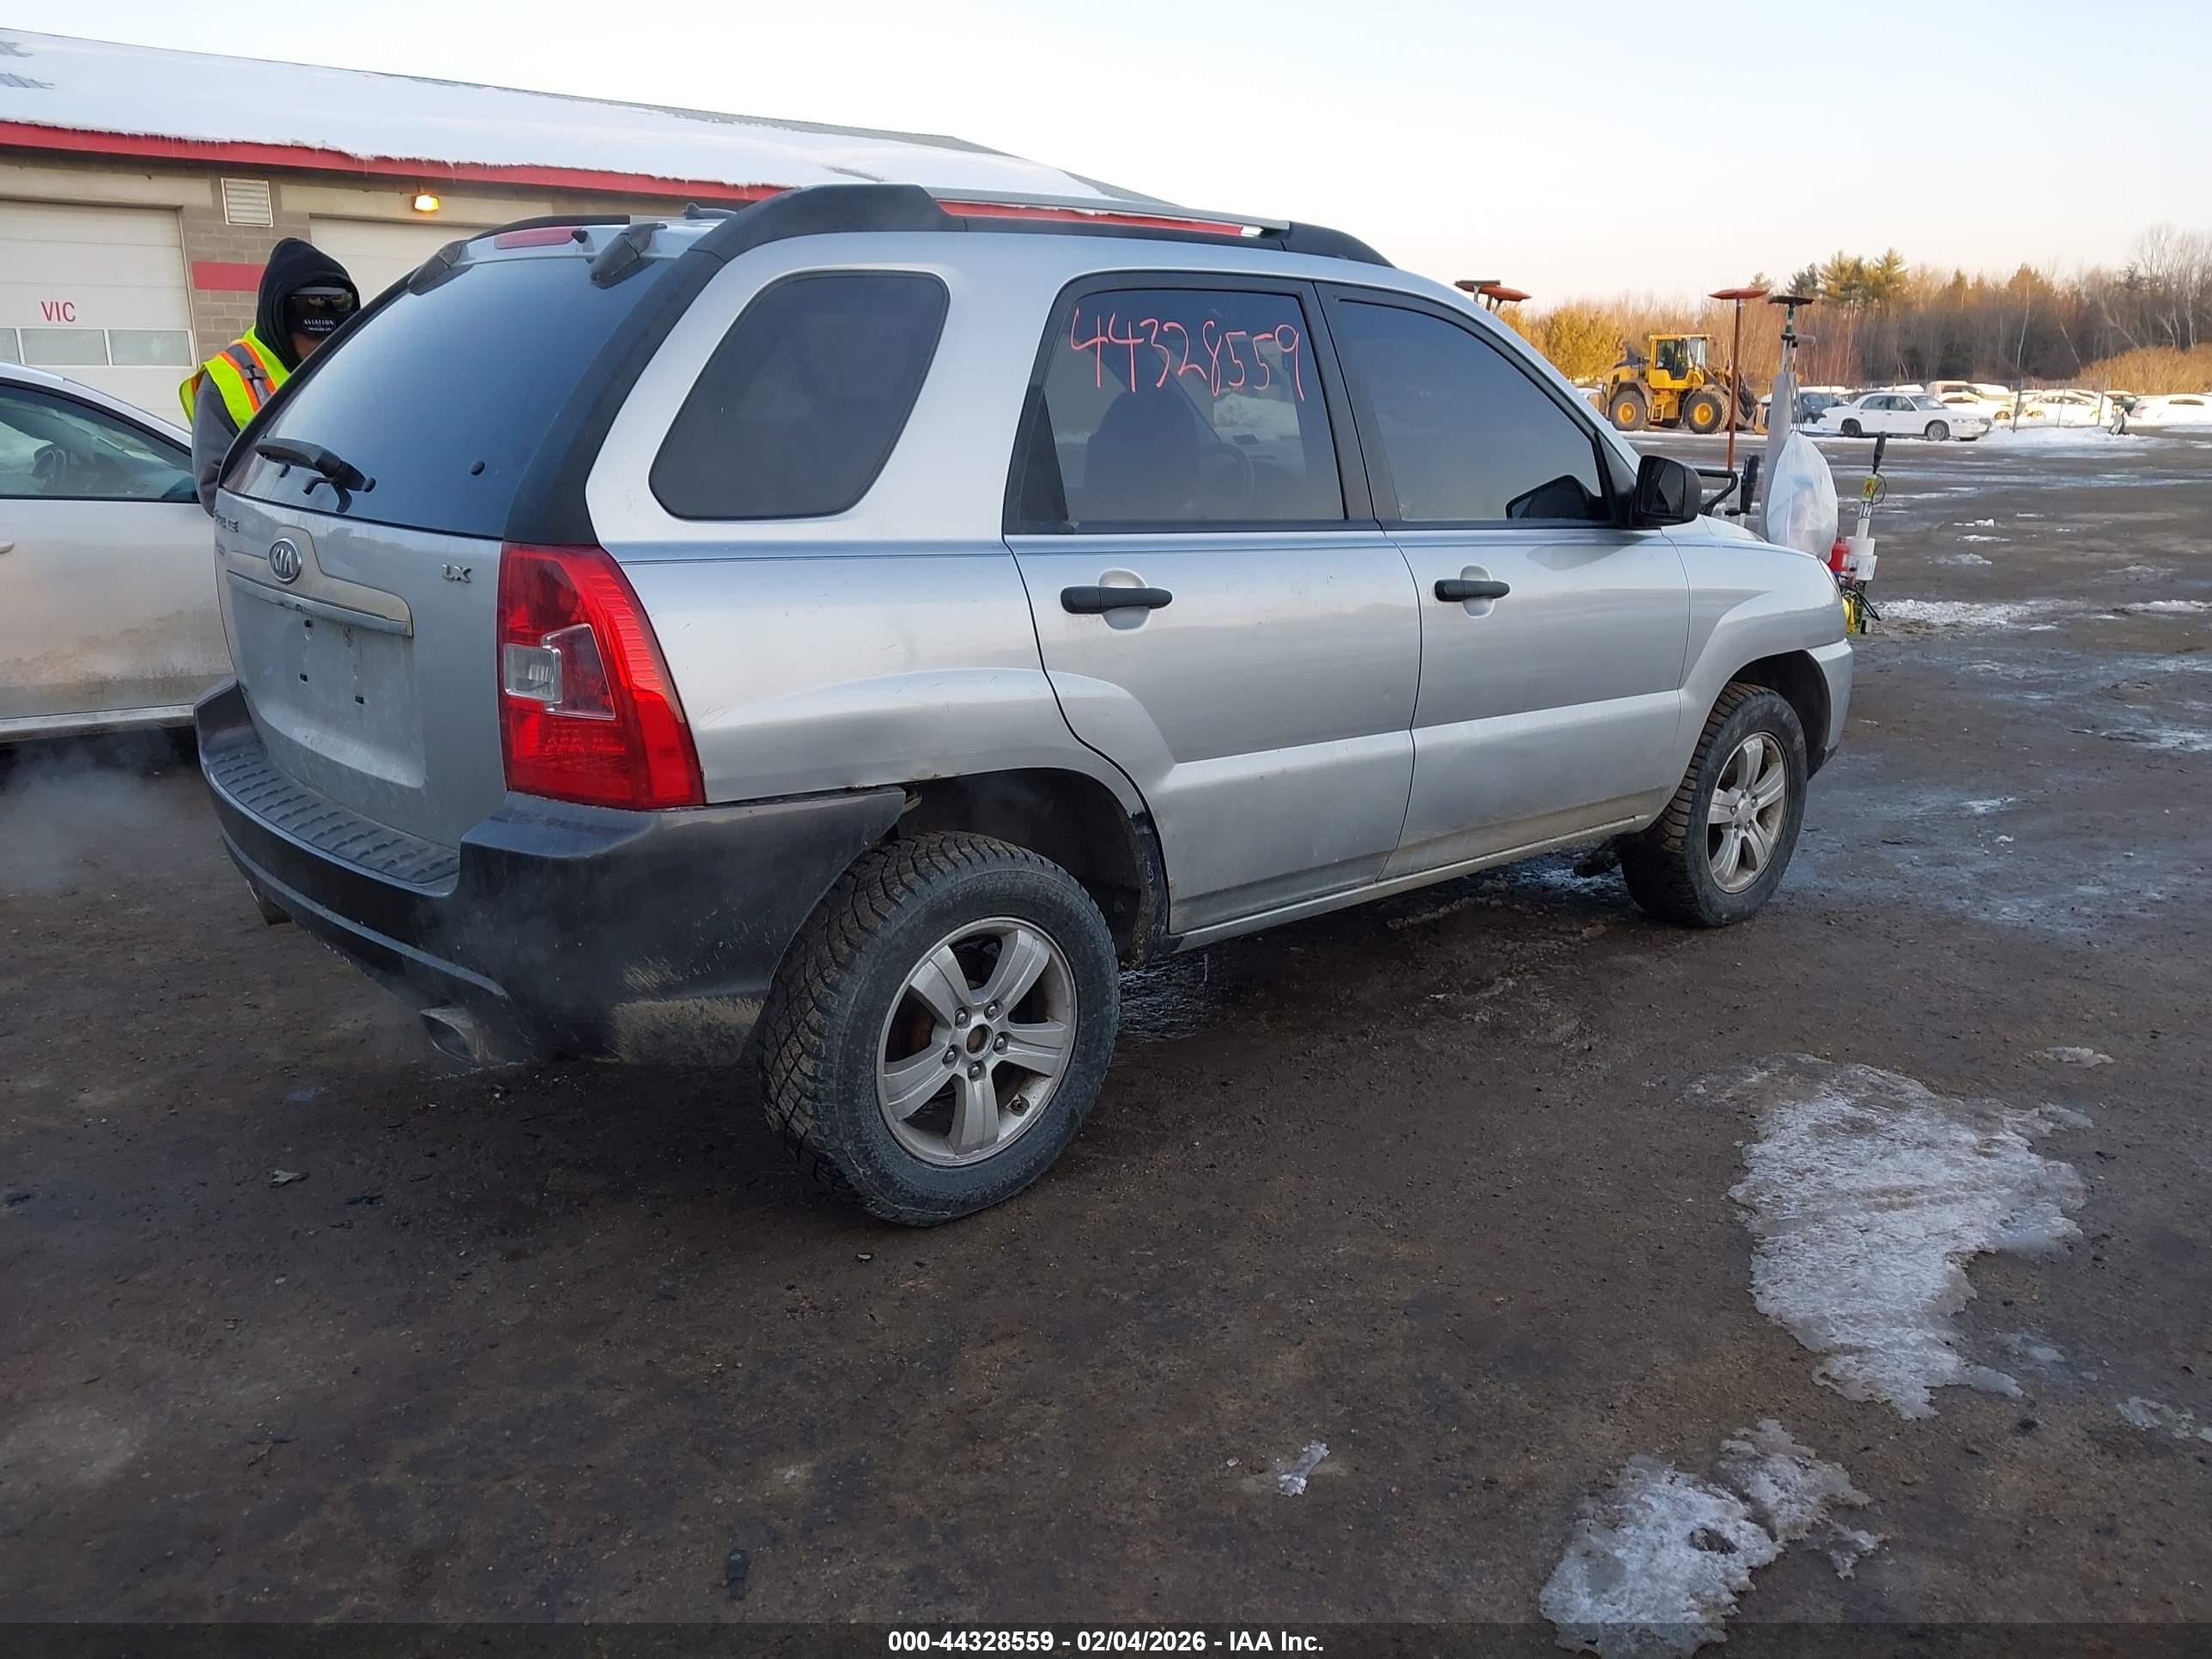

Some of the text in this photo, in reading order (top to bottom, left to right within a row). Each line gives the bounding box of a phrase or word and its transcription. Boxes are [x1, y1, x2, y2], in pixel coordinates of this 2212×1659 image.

[40, 301, 76, 323] VIC
[1071, 307, 1305, 401] 44328559
[272, 547, 293, 574] KIA
[441, 563, 472, 584] LX
